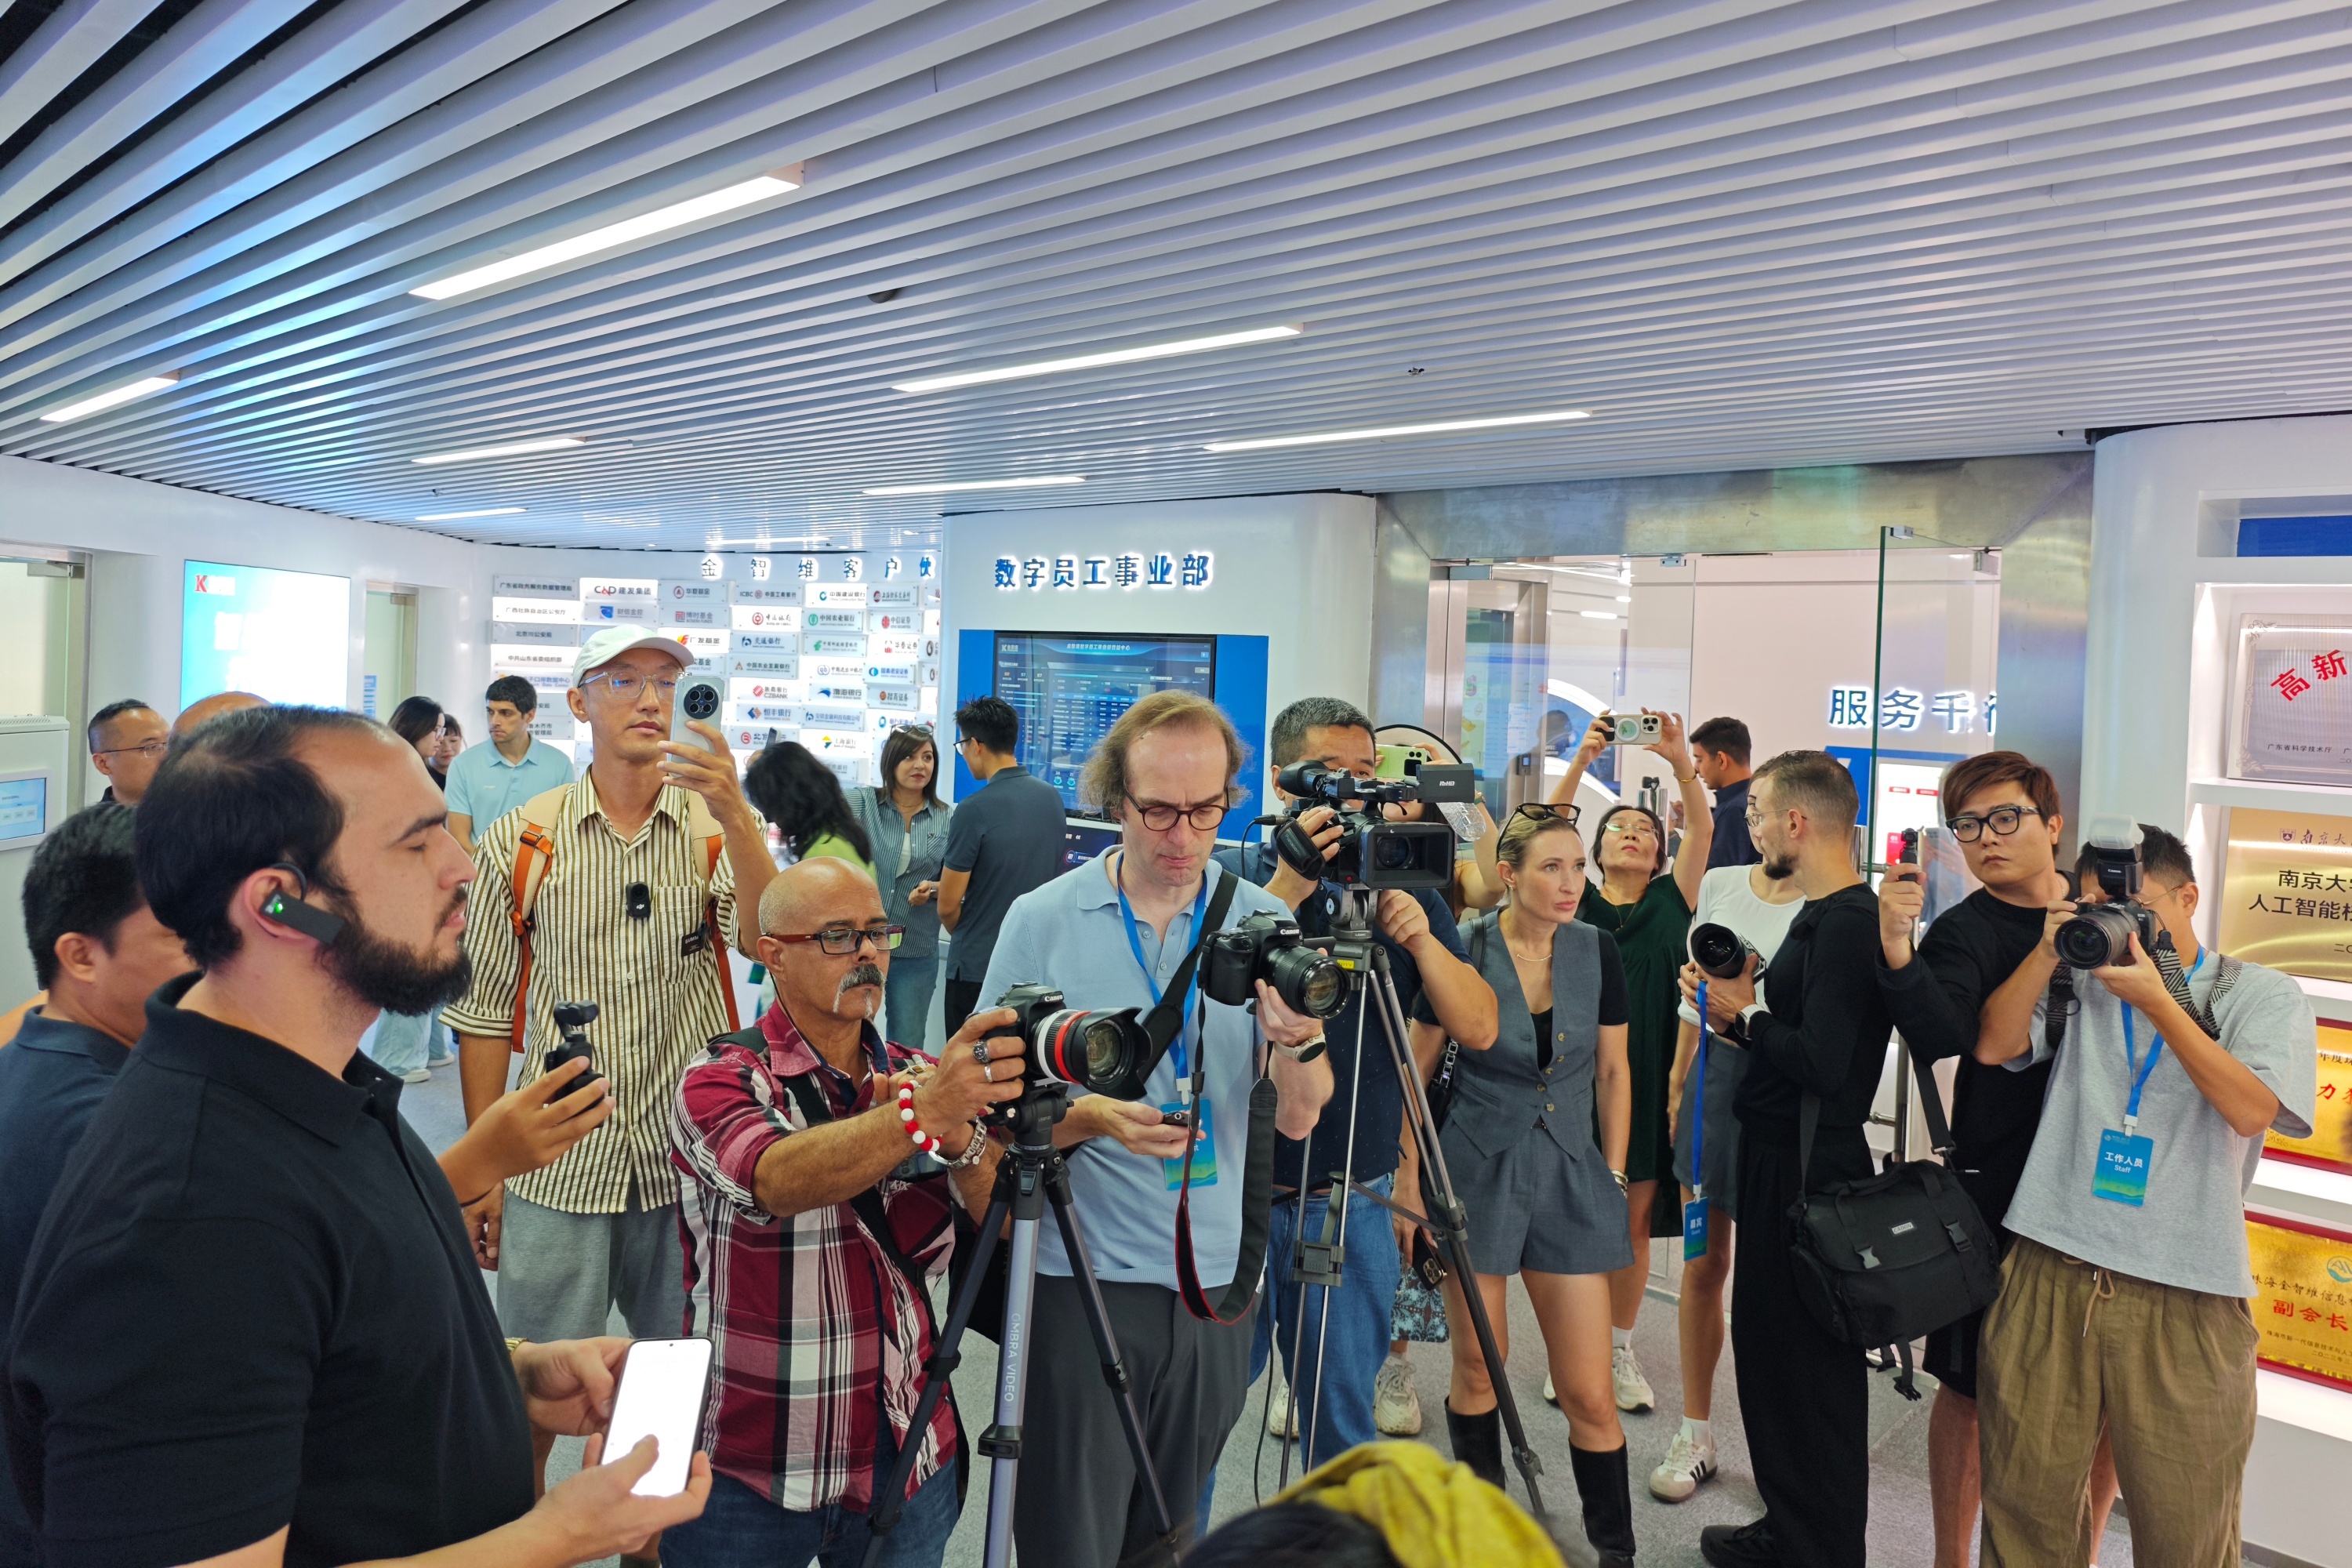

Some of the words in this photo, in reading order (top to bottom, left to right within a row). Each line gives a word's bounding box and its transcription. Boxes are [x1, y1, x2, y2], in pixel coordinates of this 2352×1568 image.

[994, 553, 1210, 588] 数字员工事业部
[618, 586, 652, 596] 建发集团
[891, 615, 911, 624] 中信证券
[754, 637, 782, 645] 交通银行
[2270, 650, 2347, 702] 高新
[764, 708, 791, 717] 恒丰银行
[2267, 744, 2332, 753] 广东省科学技术厅
[2300, 829, 2352, 845] 南京大
[2278, 869, 2352, 893] 南京大
[2104, 1151, 2143, 1168] 工作人员
[2114, 1164, 2132, 1174] Staff
[2274, 1299, 2349, 1332] 副会长
[1007, 1312, 1022, 1359] OMBRA
[1004, 1363, 1018, 1402] VIDEO
